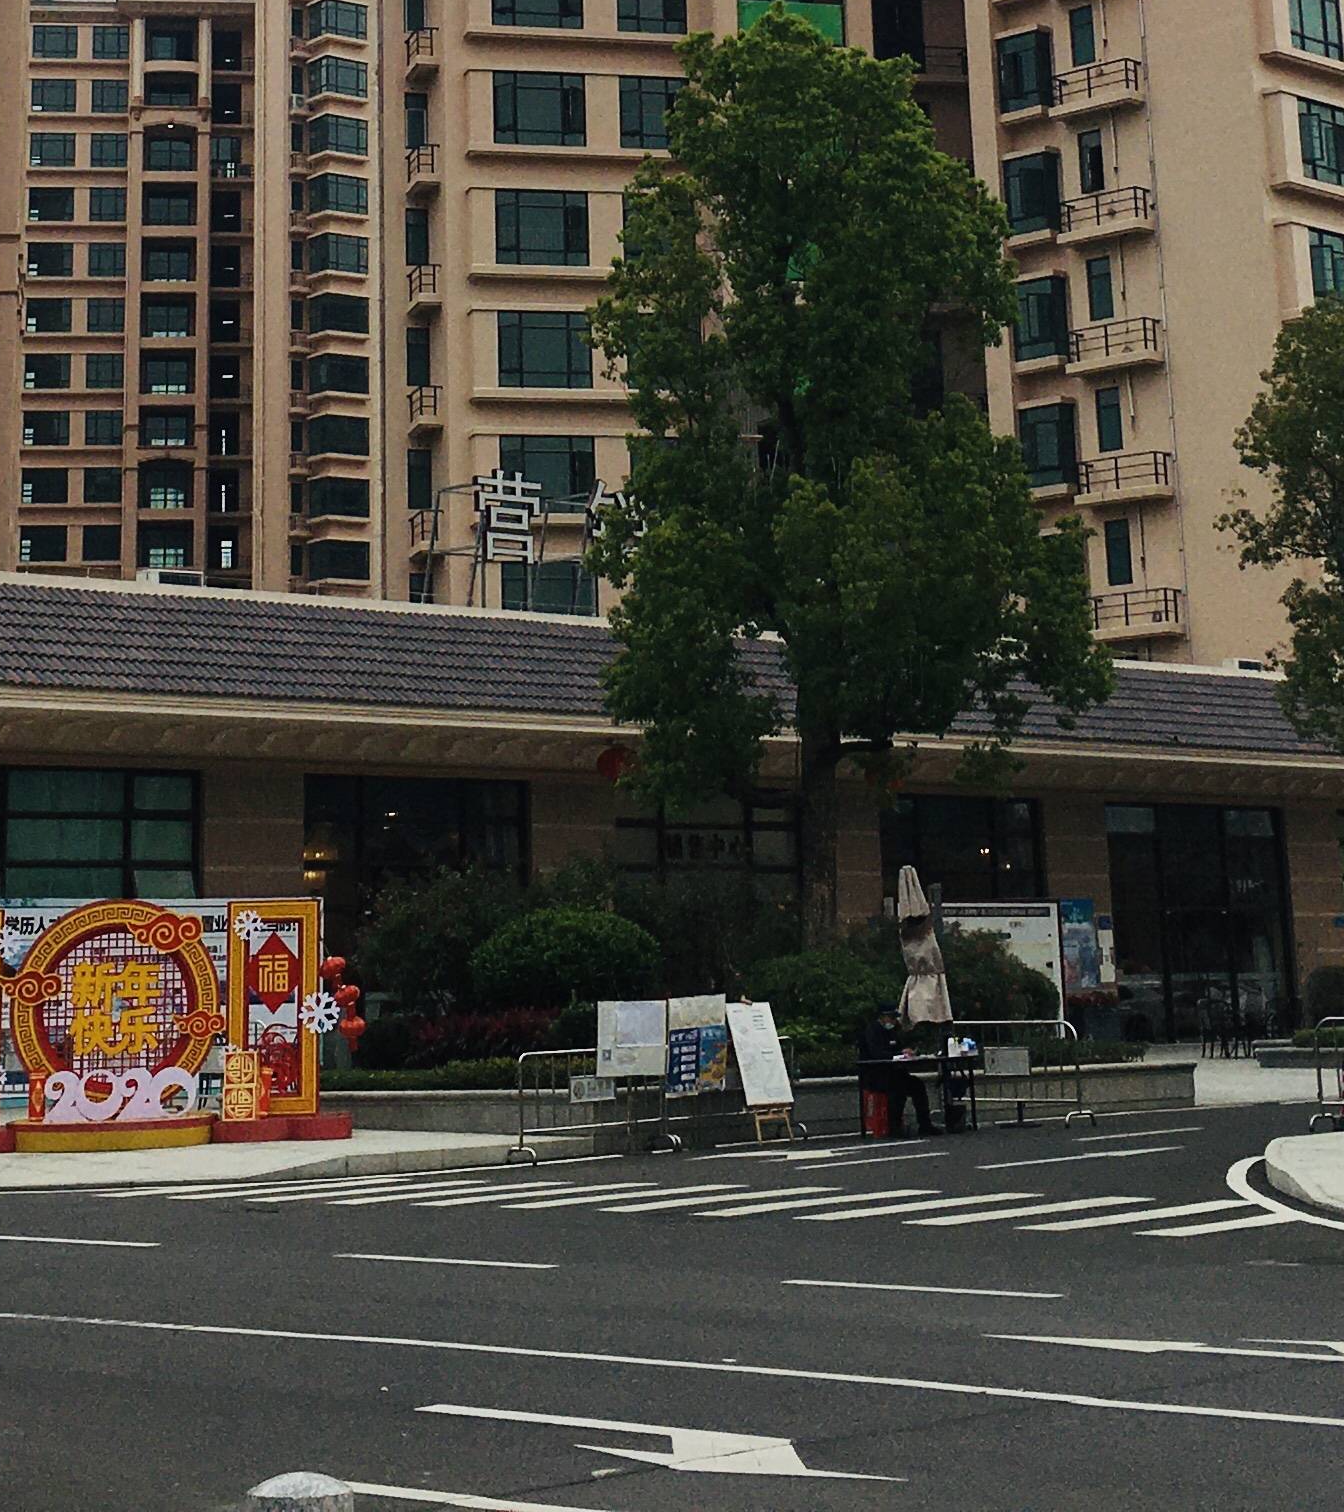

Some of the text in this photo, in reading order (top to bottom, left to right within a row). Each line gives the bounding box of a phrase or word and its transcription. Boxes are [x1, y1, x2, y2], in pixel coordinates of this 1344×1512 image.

[70, 961, 161, 1016] 新年
[258, 954, 289, 993] 福
[68, 1006, 160, 1056] 快乐
[43, 1066, 198, 1125] 2020
